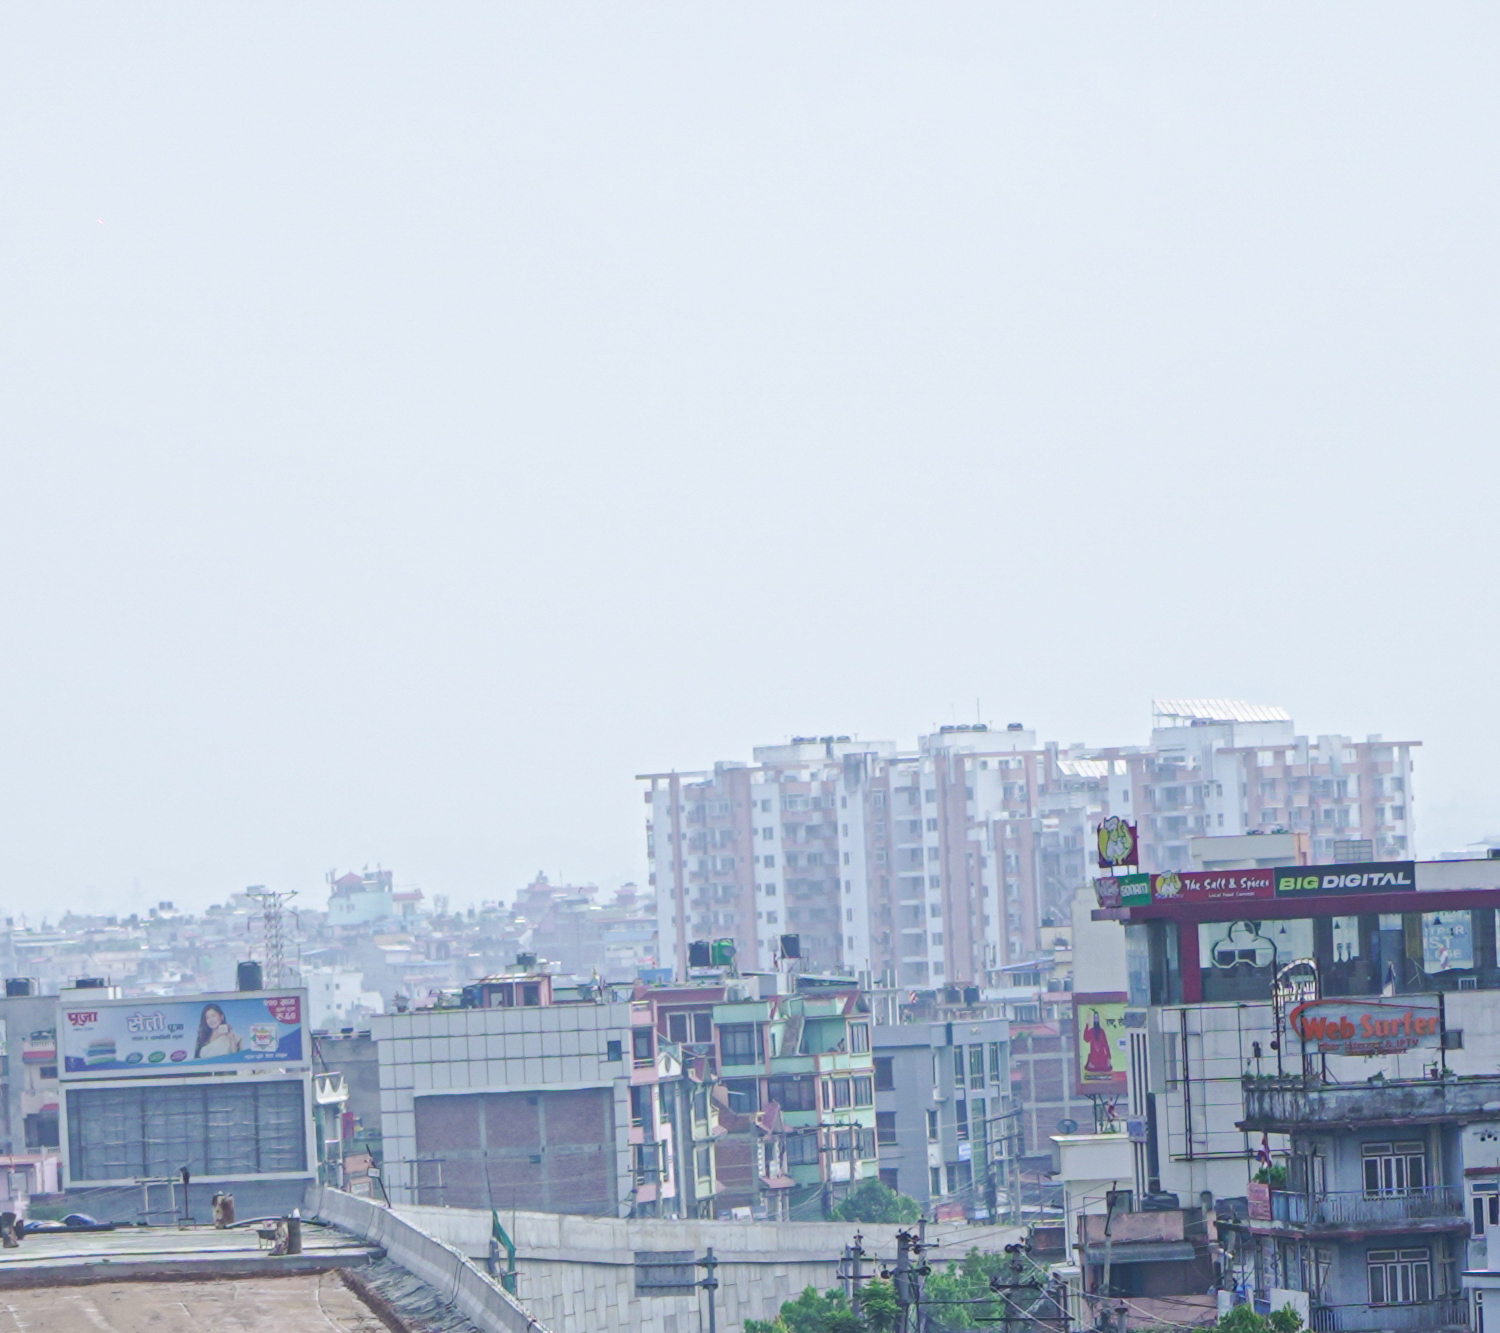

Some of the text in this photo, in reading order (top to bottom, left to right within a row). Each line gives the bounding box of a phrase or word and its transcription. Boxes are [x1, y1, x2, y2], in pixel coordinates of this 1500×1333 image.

[1185, 876, 1270, 891] The Salt & Spices
[1279, 872, 1411, 890] BIG DIGITAL
[67, 1011, 98, 1026] पूजा
[126, 1011, 165, 1033] सेतो
[1302, 1012, 1439, 1039] Web Surfer
